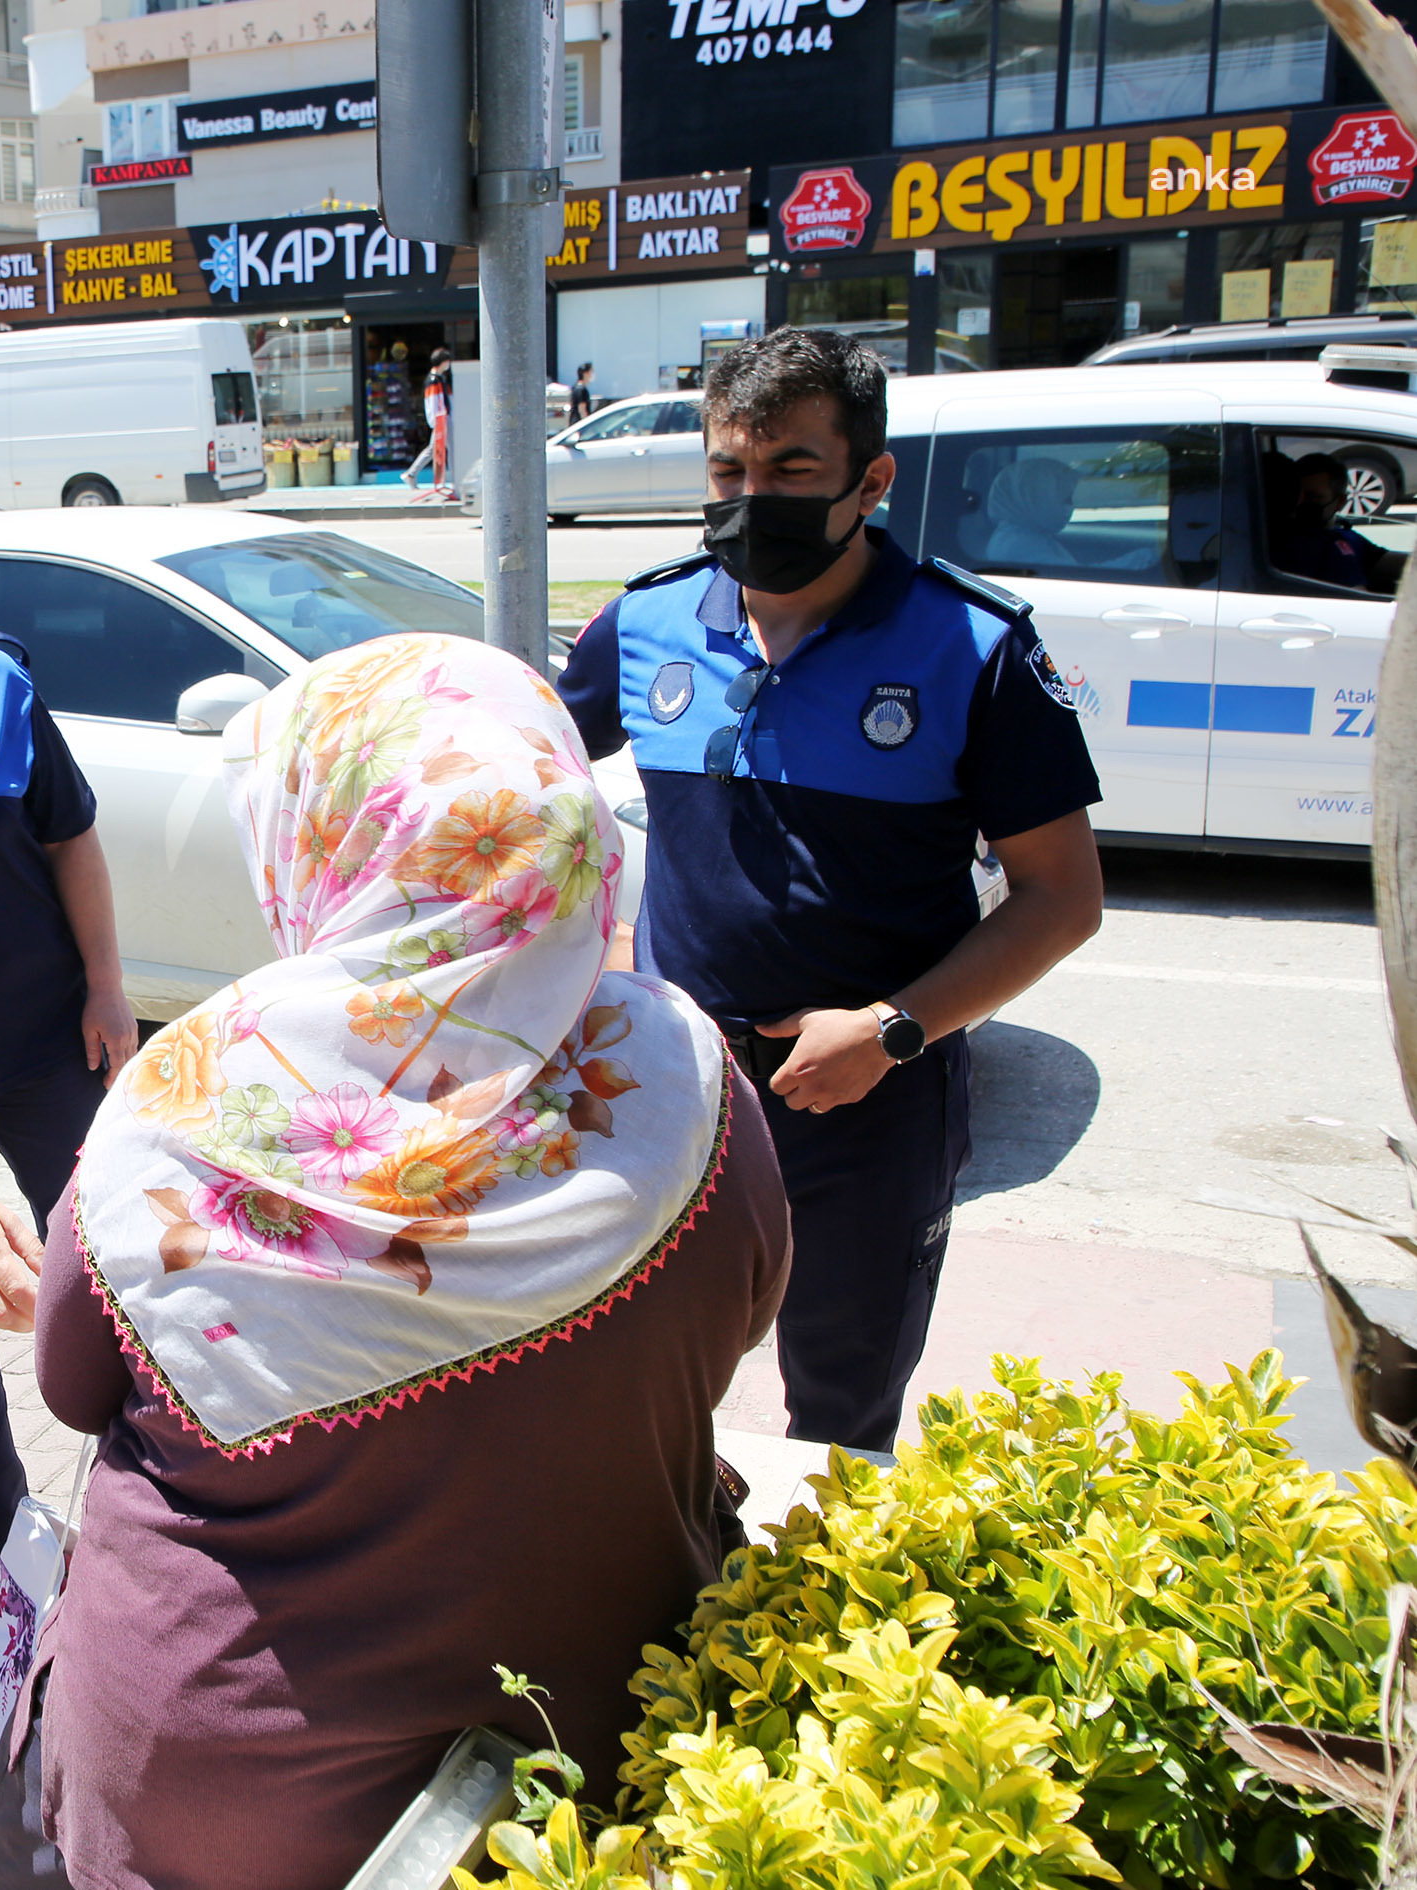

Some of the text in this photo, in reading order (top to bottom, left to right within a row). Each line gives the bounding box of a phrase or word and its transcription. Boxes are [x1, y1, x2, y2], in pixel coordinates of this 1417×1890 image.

[695, 35, 749, 66] 407
[775, 24, 833, 56] 444
[182, 114, 255, 140] Vanessa
[260, 103, 328, 131] Beauty
[94, 158, 191, 184] KAMPANYA
[891, 124, 1288, 242] BEŞYILDIZ
[64, 239, 173, 277] ŞEKERLEME
[238, 222, 437, 288] KAPTAN
[638, 225, 720, 260] AKTAR
[62, 276, 126, 305] KAHVE
[139, 271, 178, 299] BAL
[875, 687, 912, 698] ZABITA
[1333, 687, 1377, 704] Atak
[1297, 796, 1374, 816] www.a
[923, 1210, 953, 1246] ZAB
